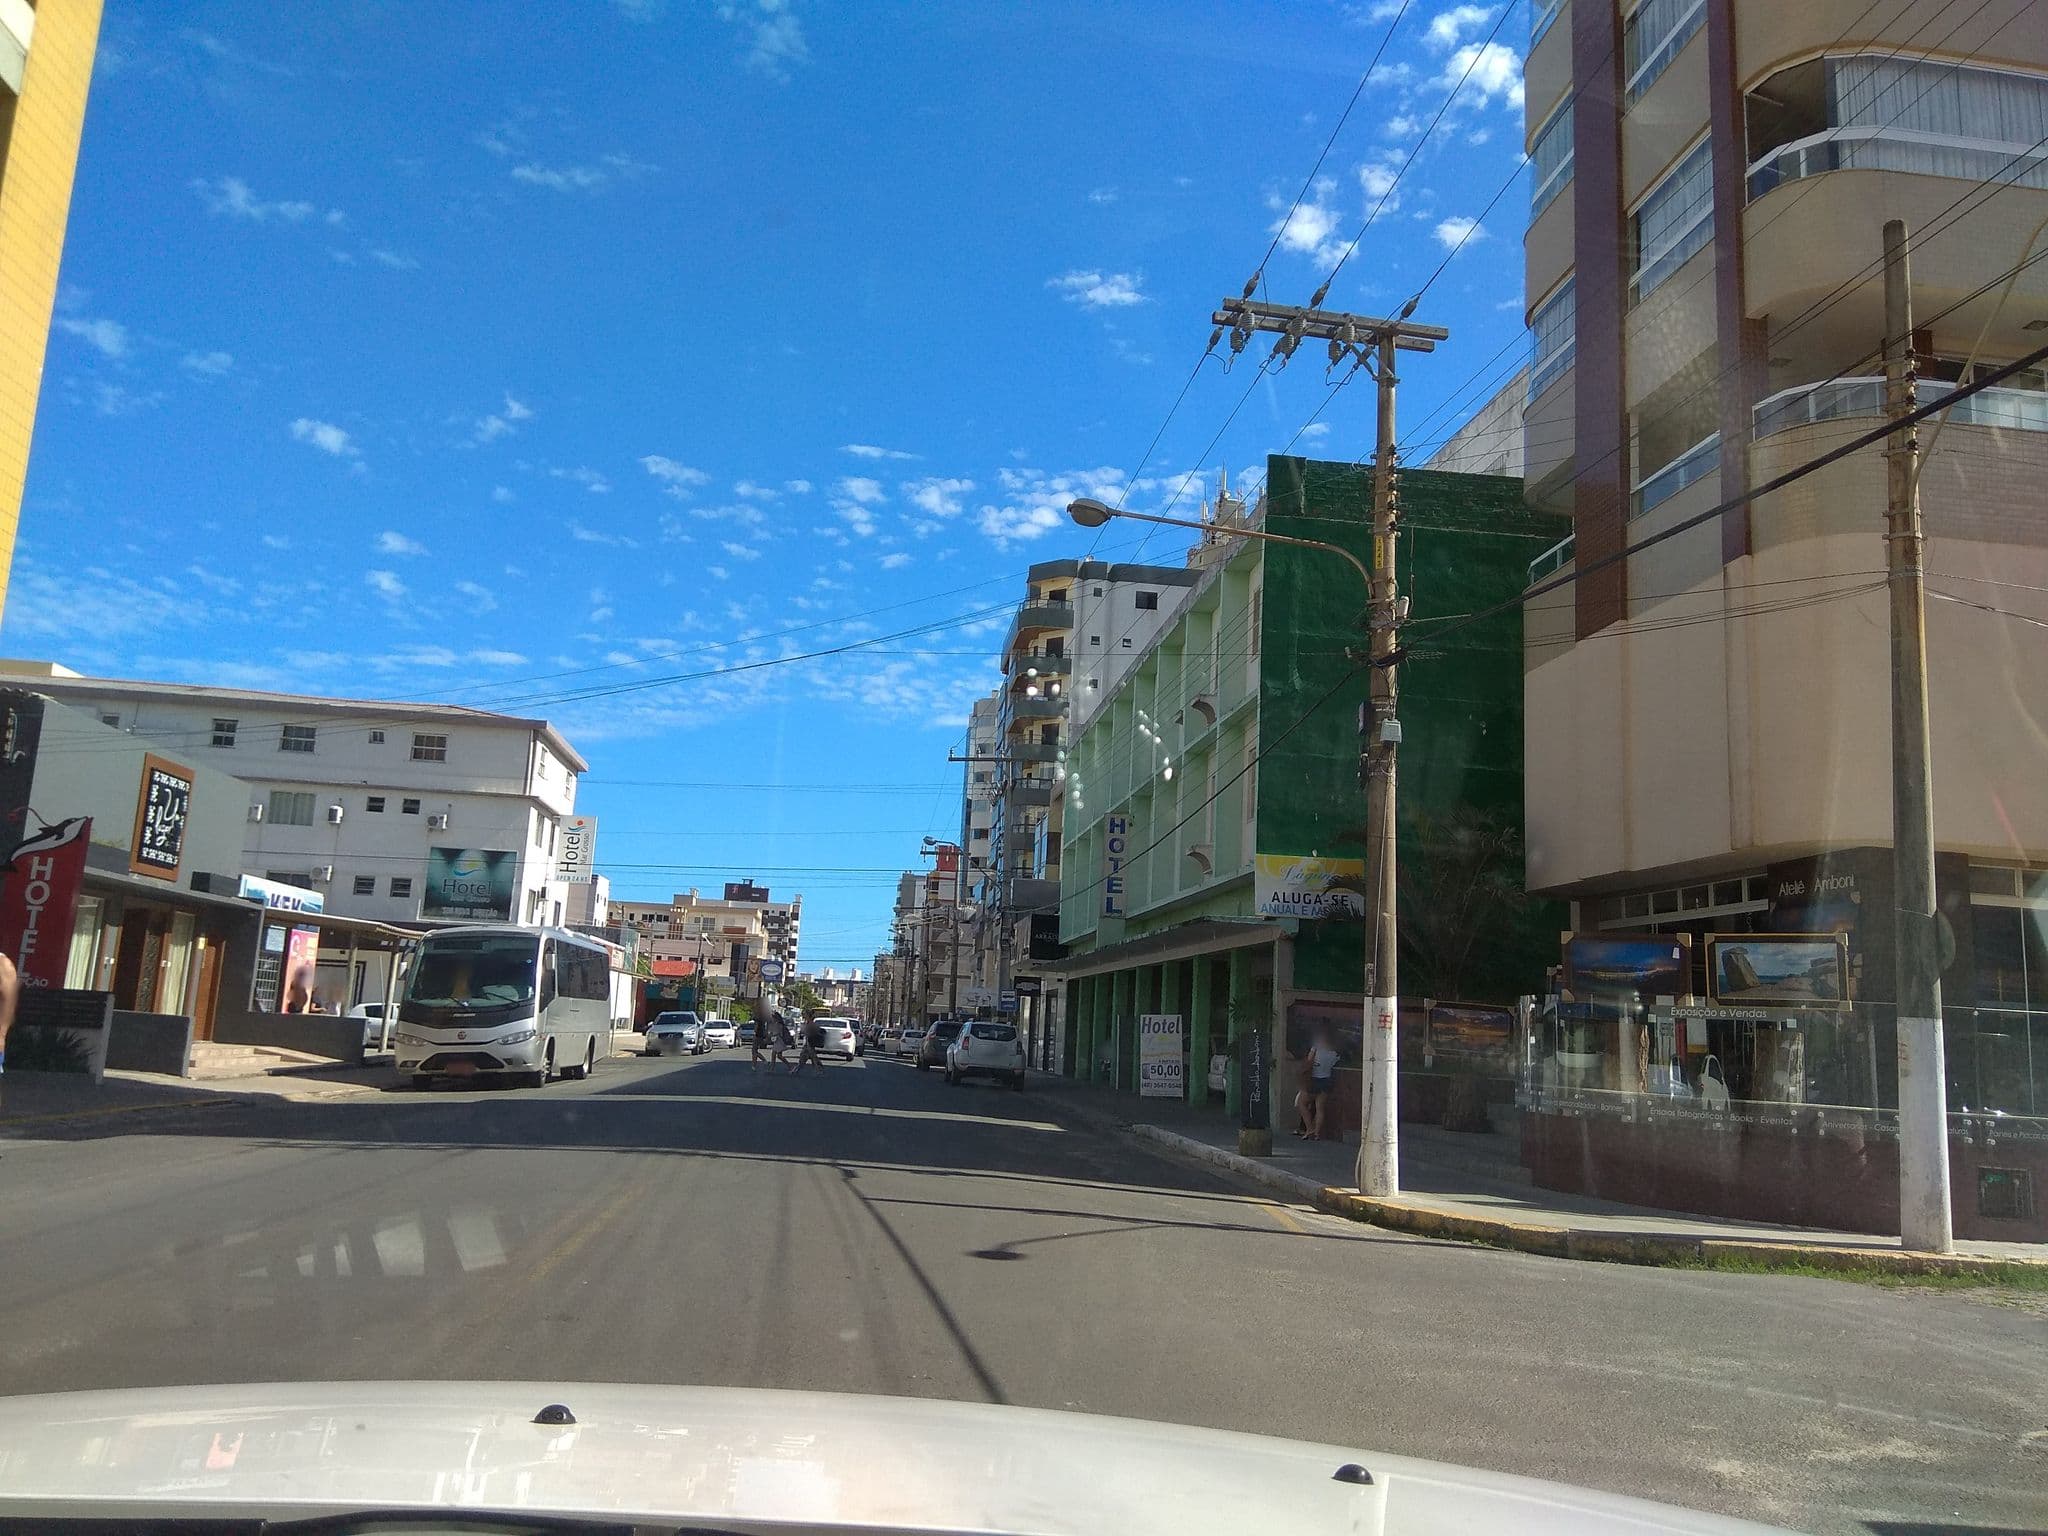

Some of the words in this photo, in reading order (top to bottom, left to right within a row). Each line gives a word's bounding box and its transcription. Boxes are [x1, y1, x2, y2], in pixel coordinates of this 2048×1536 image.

[559, 832, 581, 873] Hotel
[1105, 817, 1126, 914] HOTEL
[442, 878, 492, 895] Hotel
[1271, 891, 1349, 907] ALUGA-SE
[17, 856, 54, 977] HOTEL
[1260, 904, 1299, 916] ANUAL
[1670, 1006, 1717, 1019] Exposição
[1729, 1008, 1768, 1018] Vendas
[1141, 1016, 1180, 1034] Hotel
[1150, 1064, 1180, 1078] 50,00
[1730, 1114, 1754, 1123] Books
[1760, 1116, 1793, 1126] Eventos
